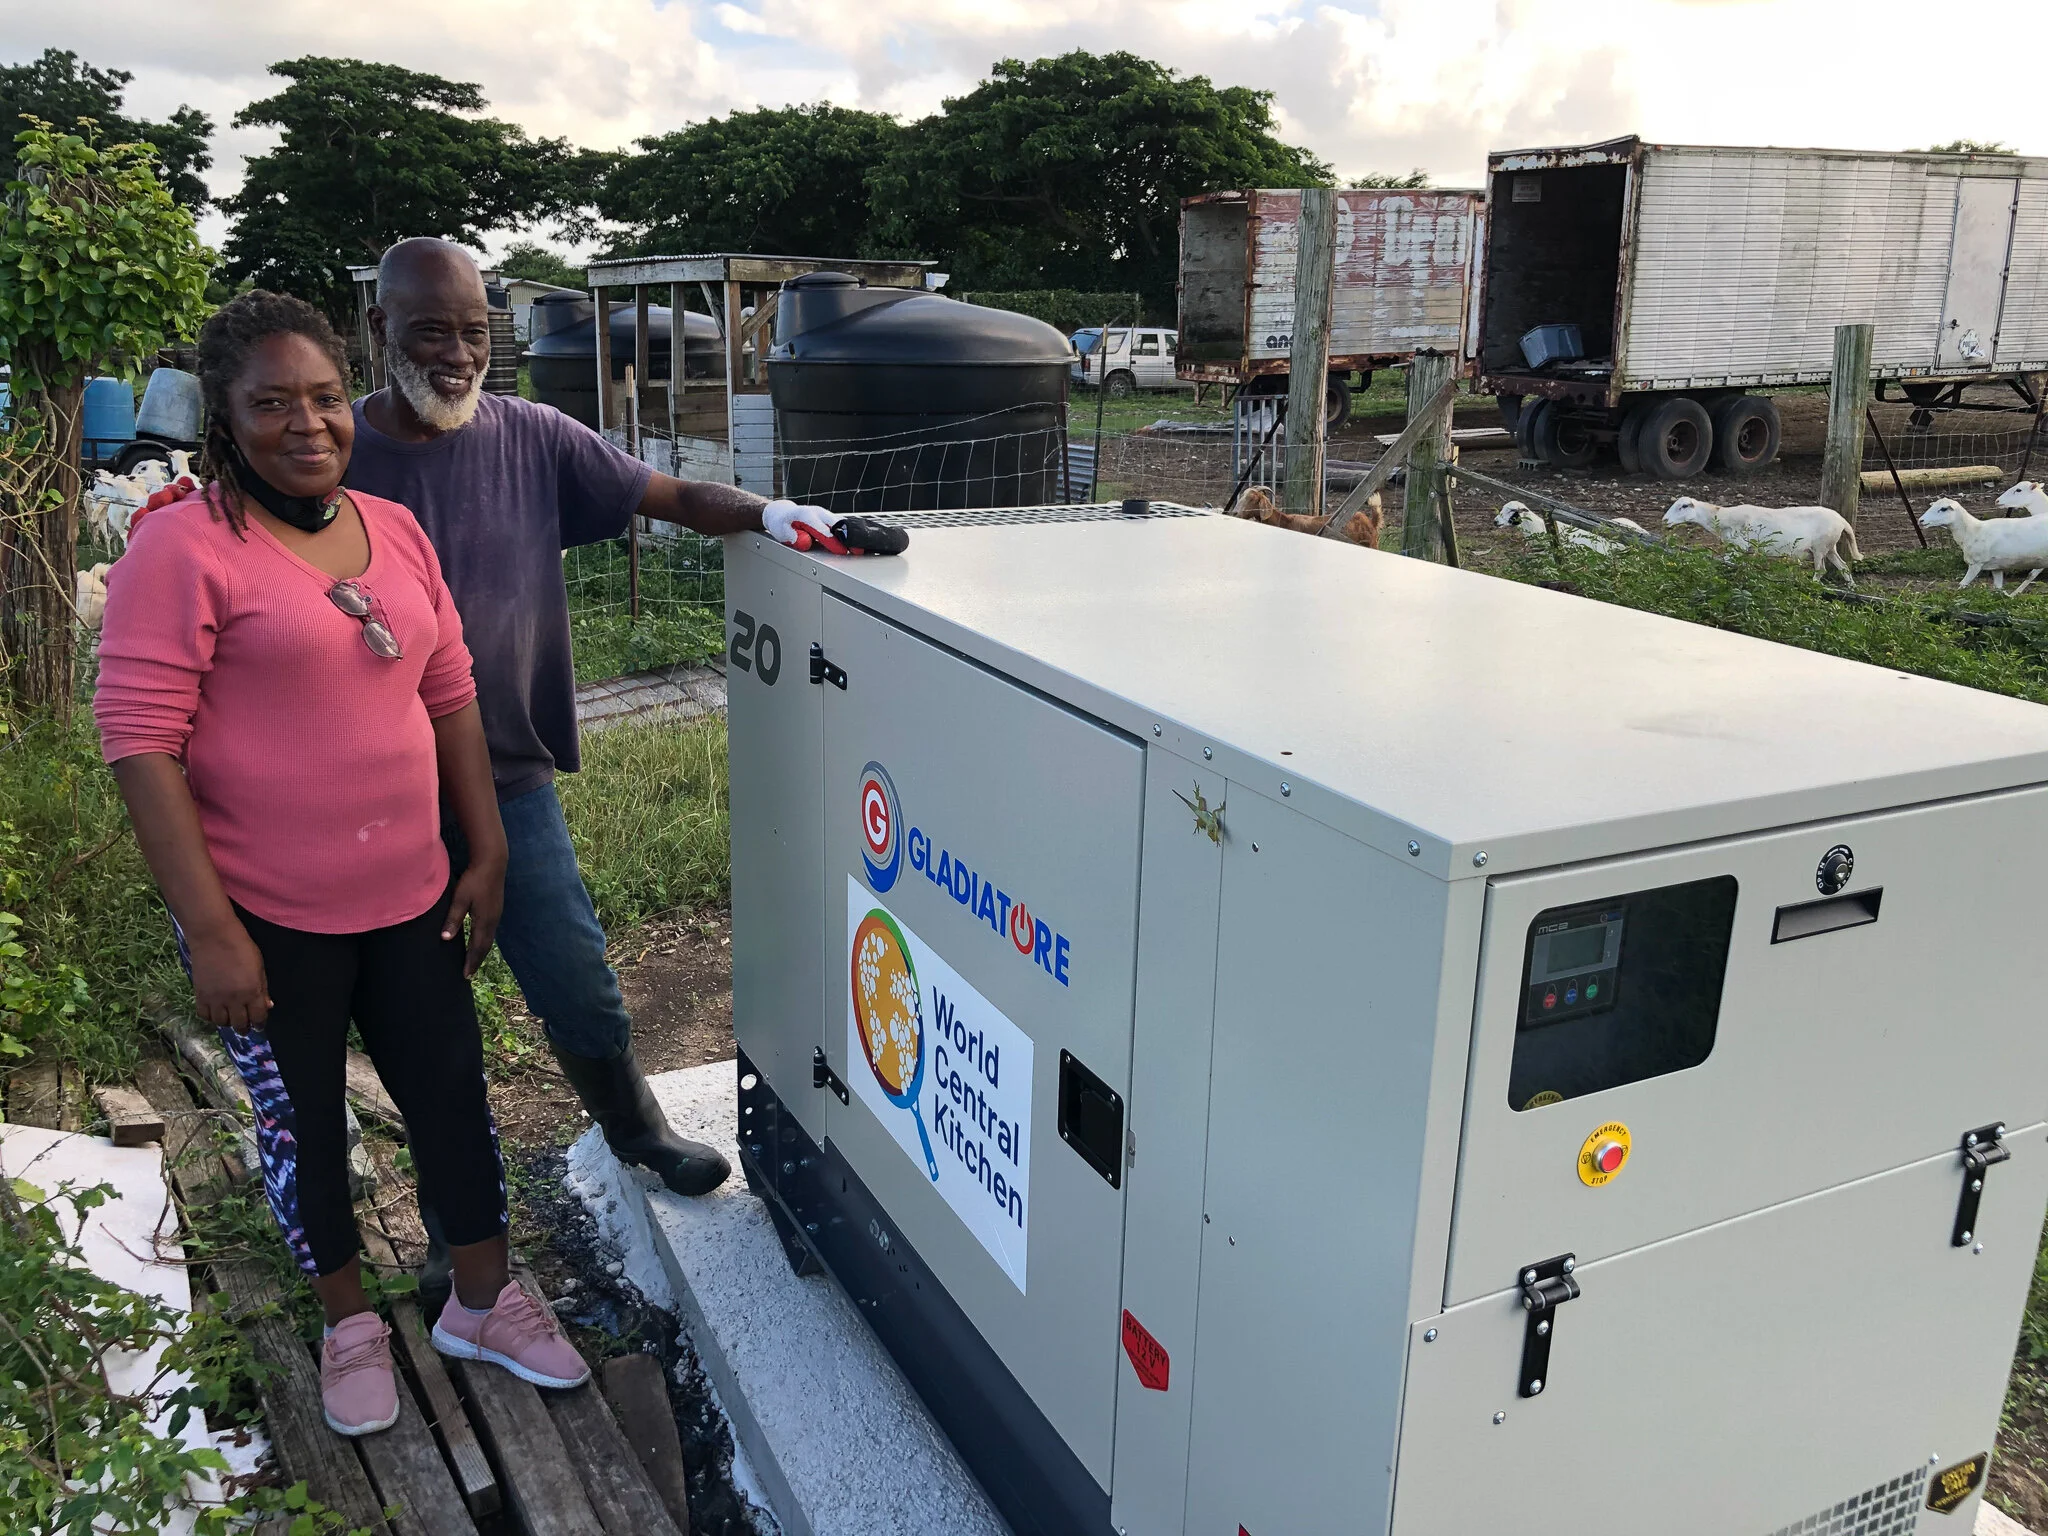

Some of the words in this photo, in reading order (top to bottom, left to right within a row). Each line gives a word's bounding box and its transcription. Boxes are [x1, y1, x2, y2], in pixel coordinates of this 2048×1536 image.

[729, 609, 782, 687] 20
[865, 789, 887, 847] G
[908, 826, 1070, 988] GLADIATORE
[932, 985, 999, 1089] World
[935, 1044, 1020, 1167] Central
[1590, 1124, 1627, 1143] EMERGENCY
[934, 1094, 1023, 1229] Kitchen
[1591, 1175, 1608, 1184] STOP
[1126, 1317, 1165, 1366] BATTERY
